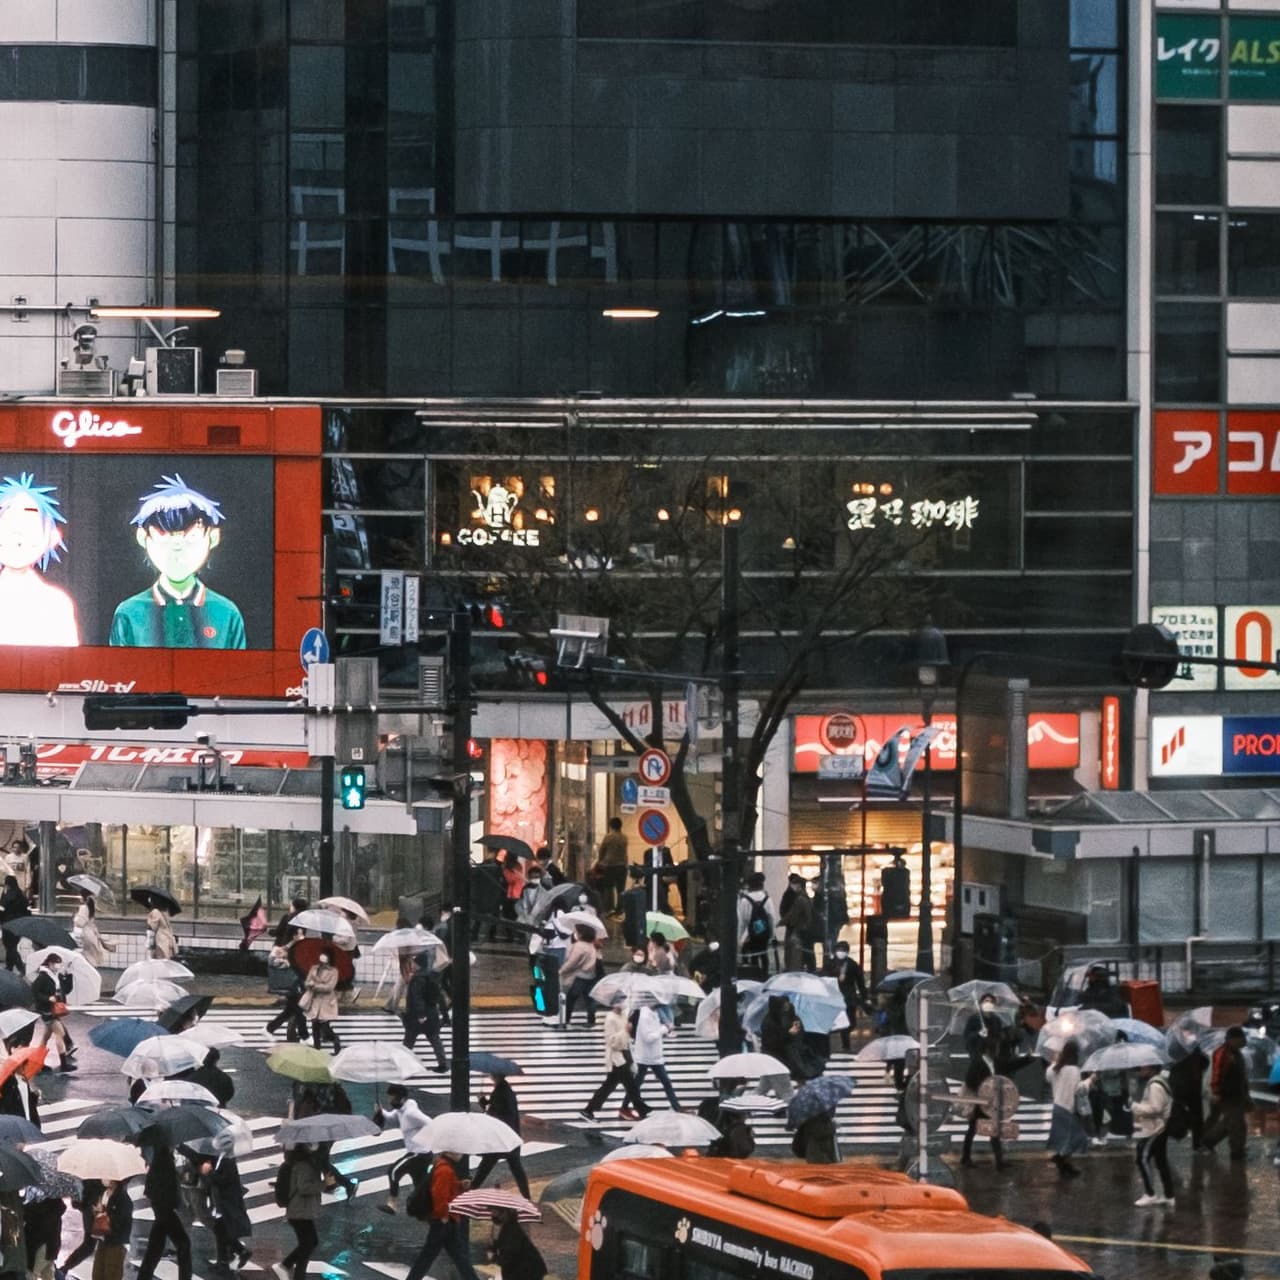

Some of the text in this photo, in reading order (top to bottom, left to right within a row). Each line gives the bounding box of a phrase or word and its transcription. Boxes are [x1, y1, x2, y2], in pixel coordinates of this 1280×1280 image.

[1156, 36, 1221, 62] レイク
[52, 410, 142, 447] Glico
[1173, 430, 1280, 474] アコ
[691, 1227, 814, 1280] SHIBUYA community bus HACHIKO
